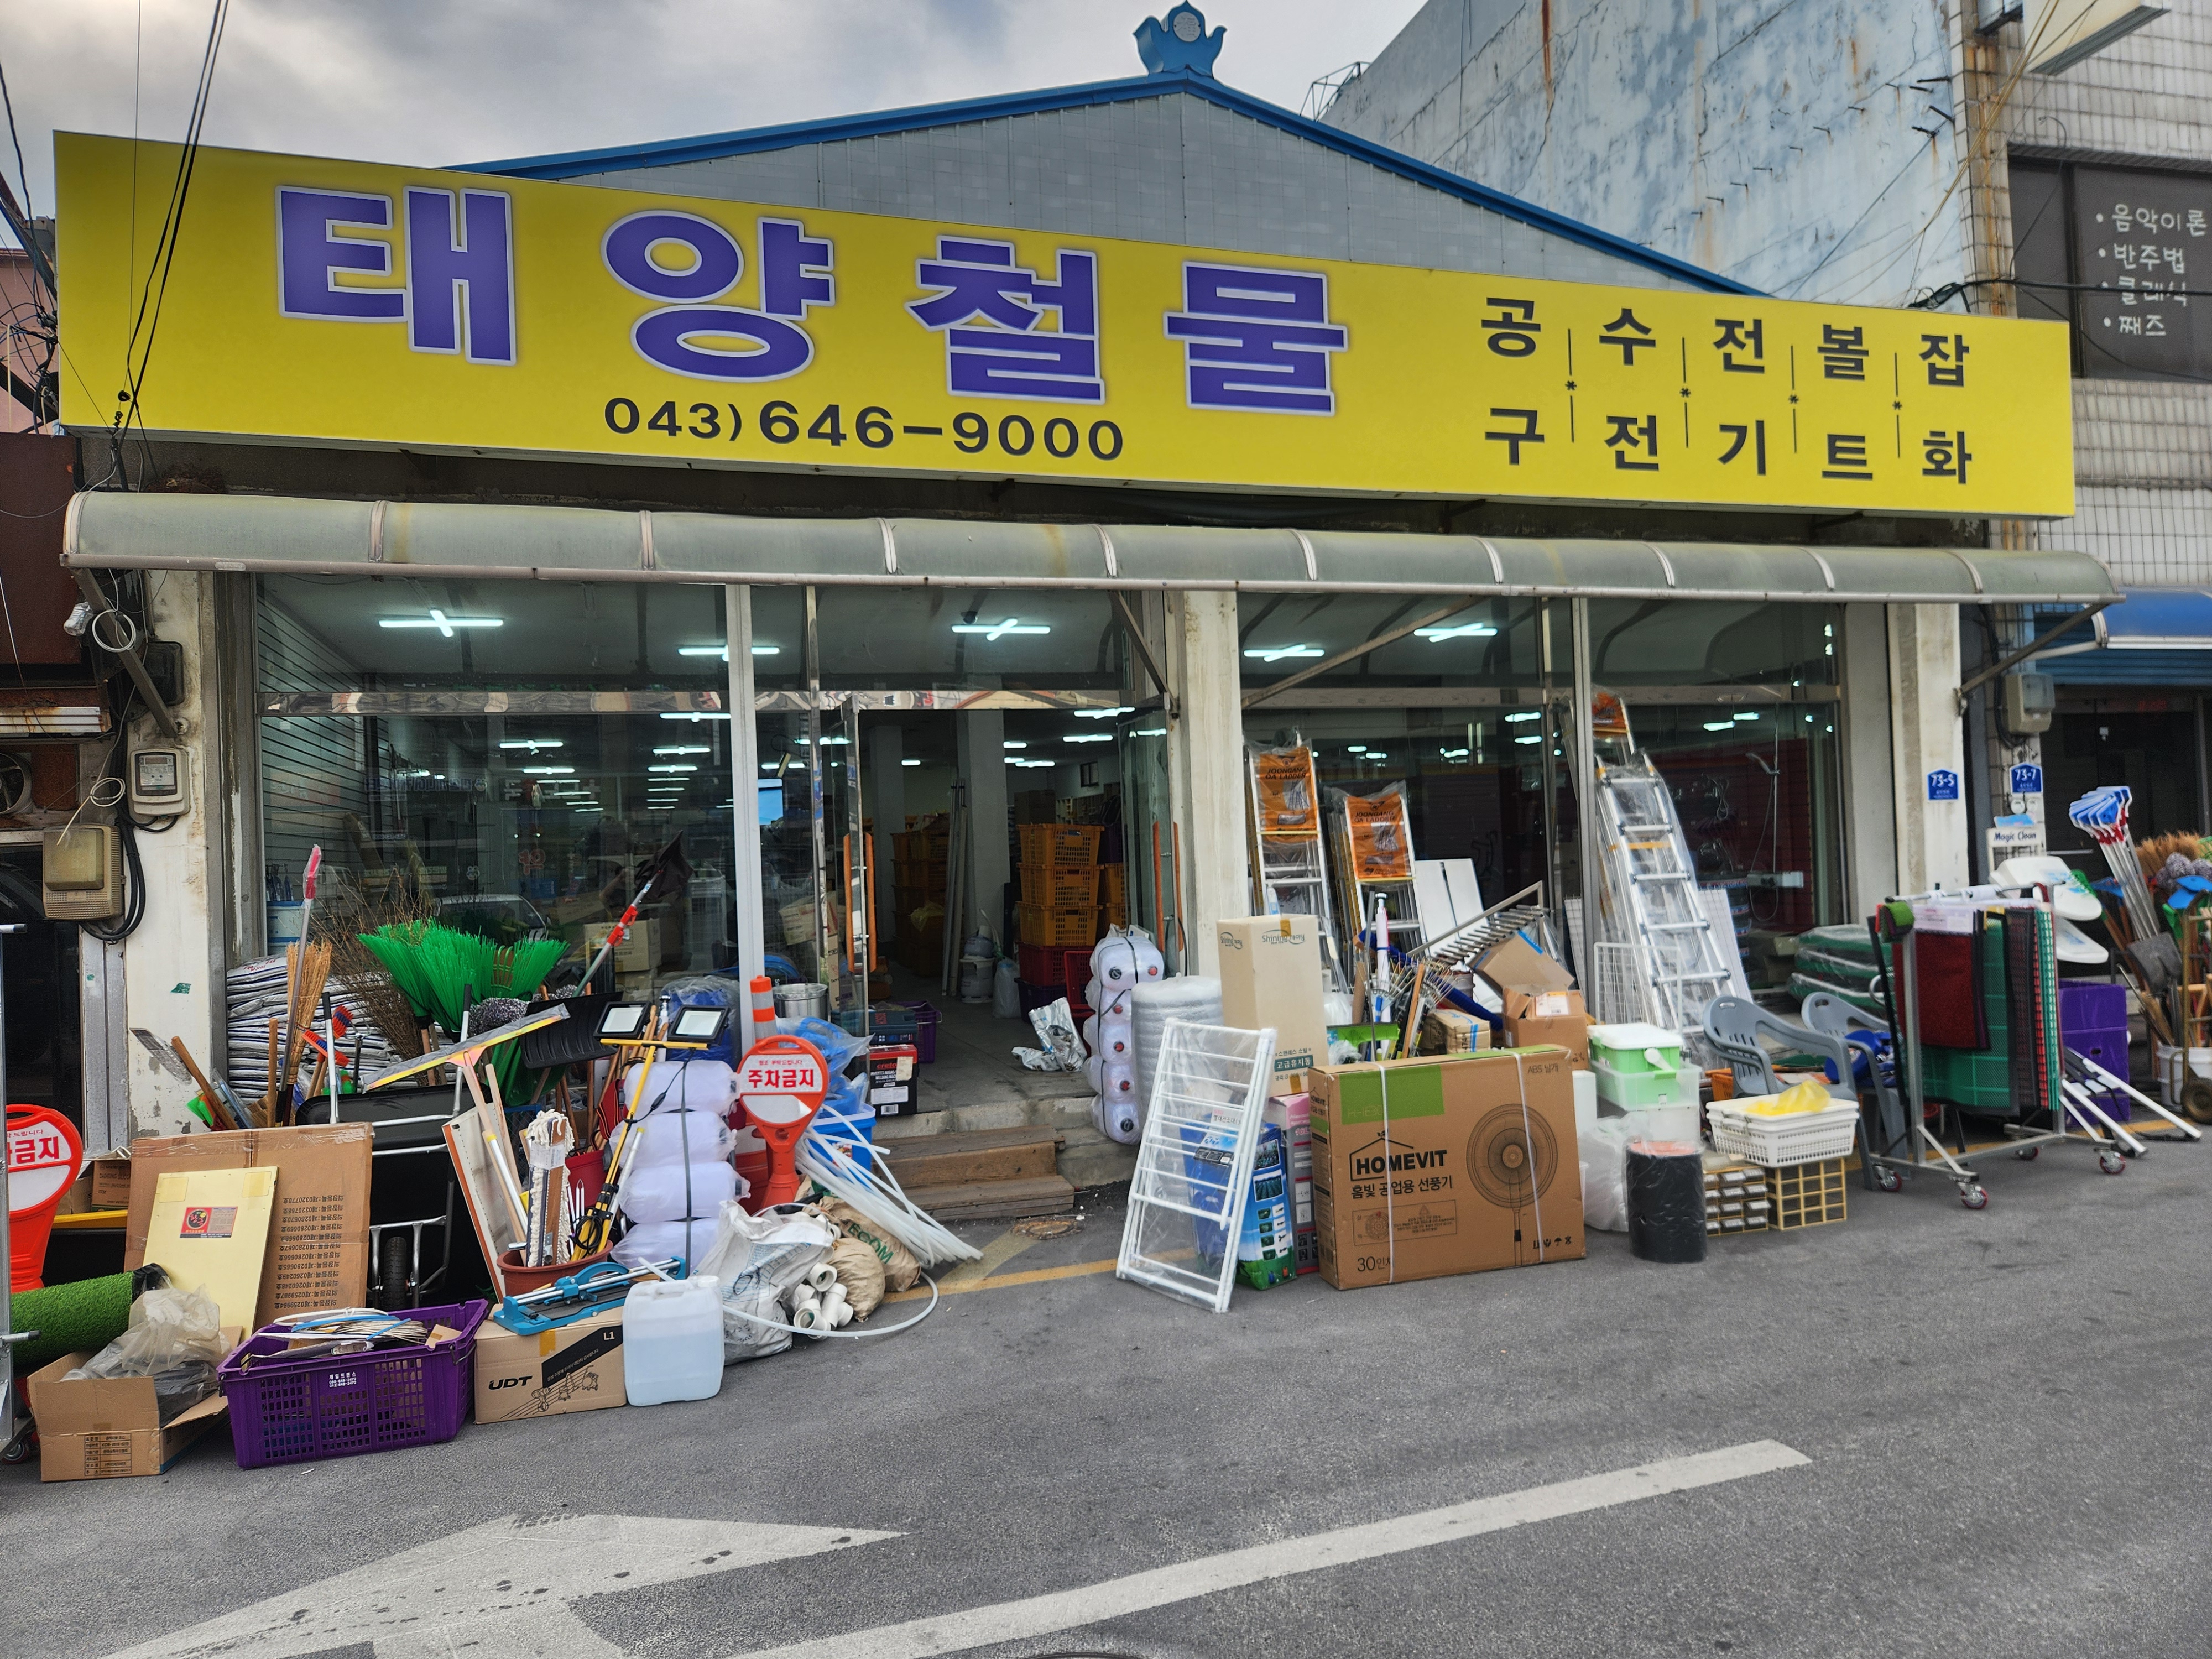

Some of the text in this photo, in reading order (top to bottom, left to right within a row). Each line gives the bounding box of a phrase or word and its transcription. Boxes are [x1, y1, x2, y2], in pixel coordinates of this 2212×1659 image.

[2112, 204, 2207, 237] 음악이론
[2114, 243, 2185, 274] 반주법
[275, 185, 1348, 416] 태양철물
[1261, 934, 1288, 943] Shining
[1276, 1057, 1311, 1069] 고급휴지통
[1528, 1065, 1543, 1074] ABS
[748, 1069, 813, 1088] 주차금지
[1356, 1150, 1447, 1175] HOMEVIT
[1352, 1175, 1453, 1199] 홈빛 공업용 선풍기
[603, 1331, 615, 1341] L1
[488, 1375, 533, 1390] UDT
